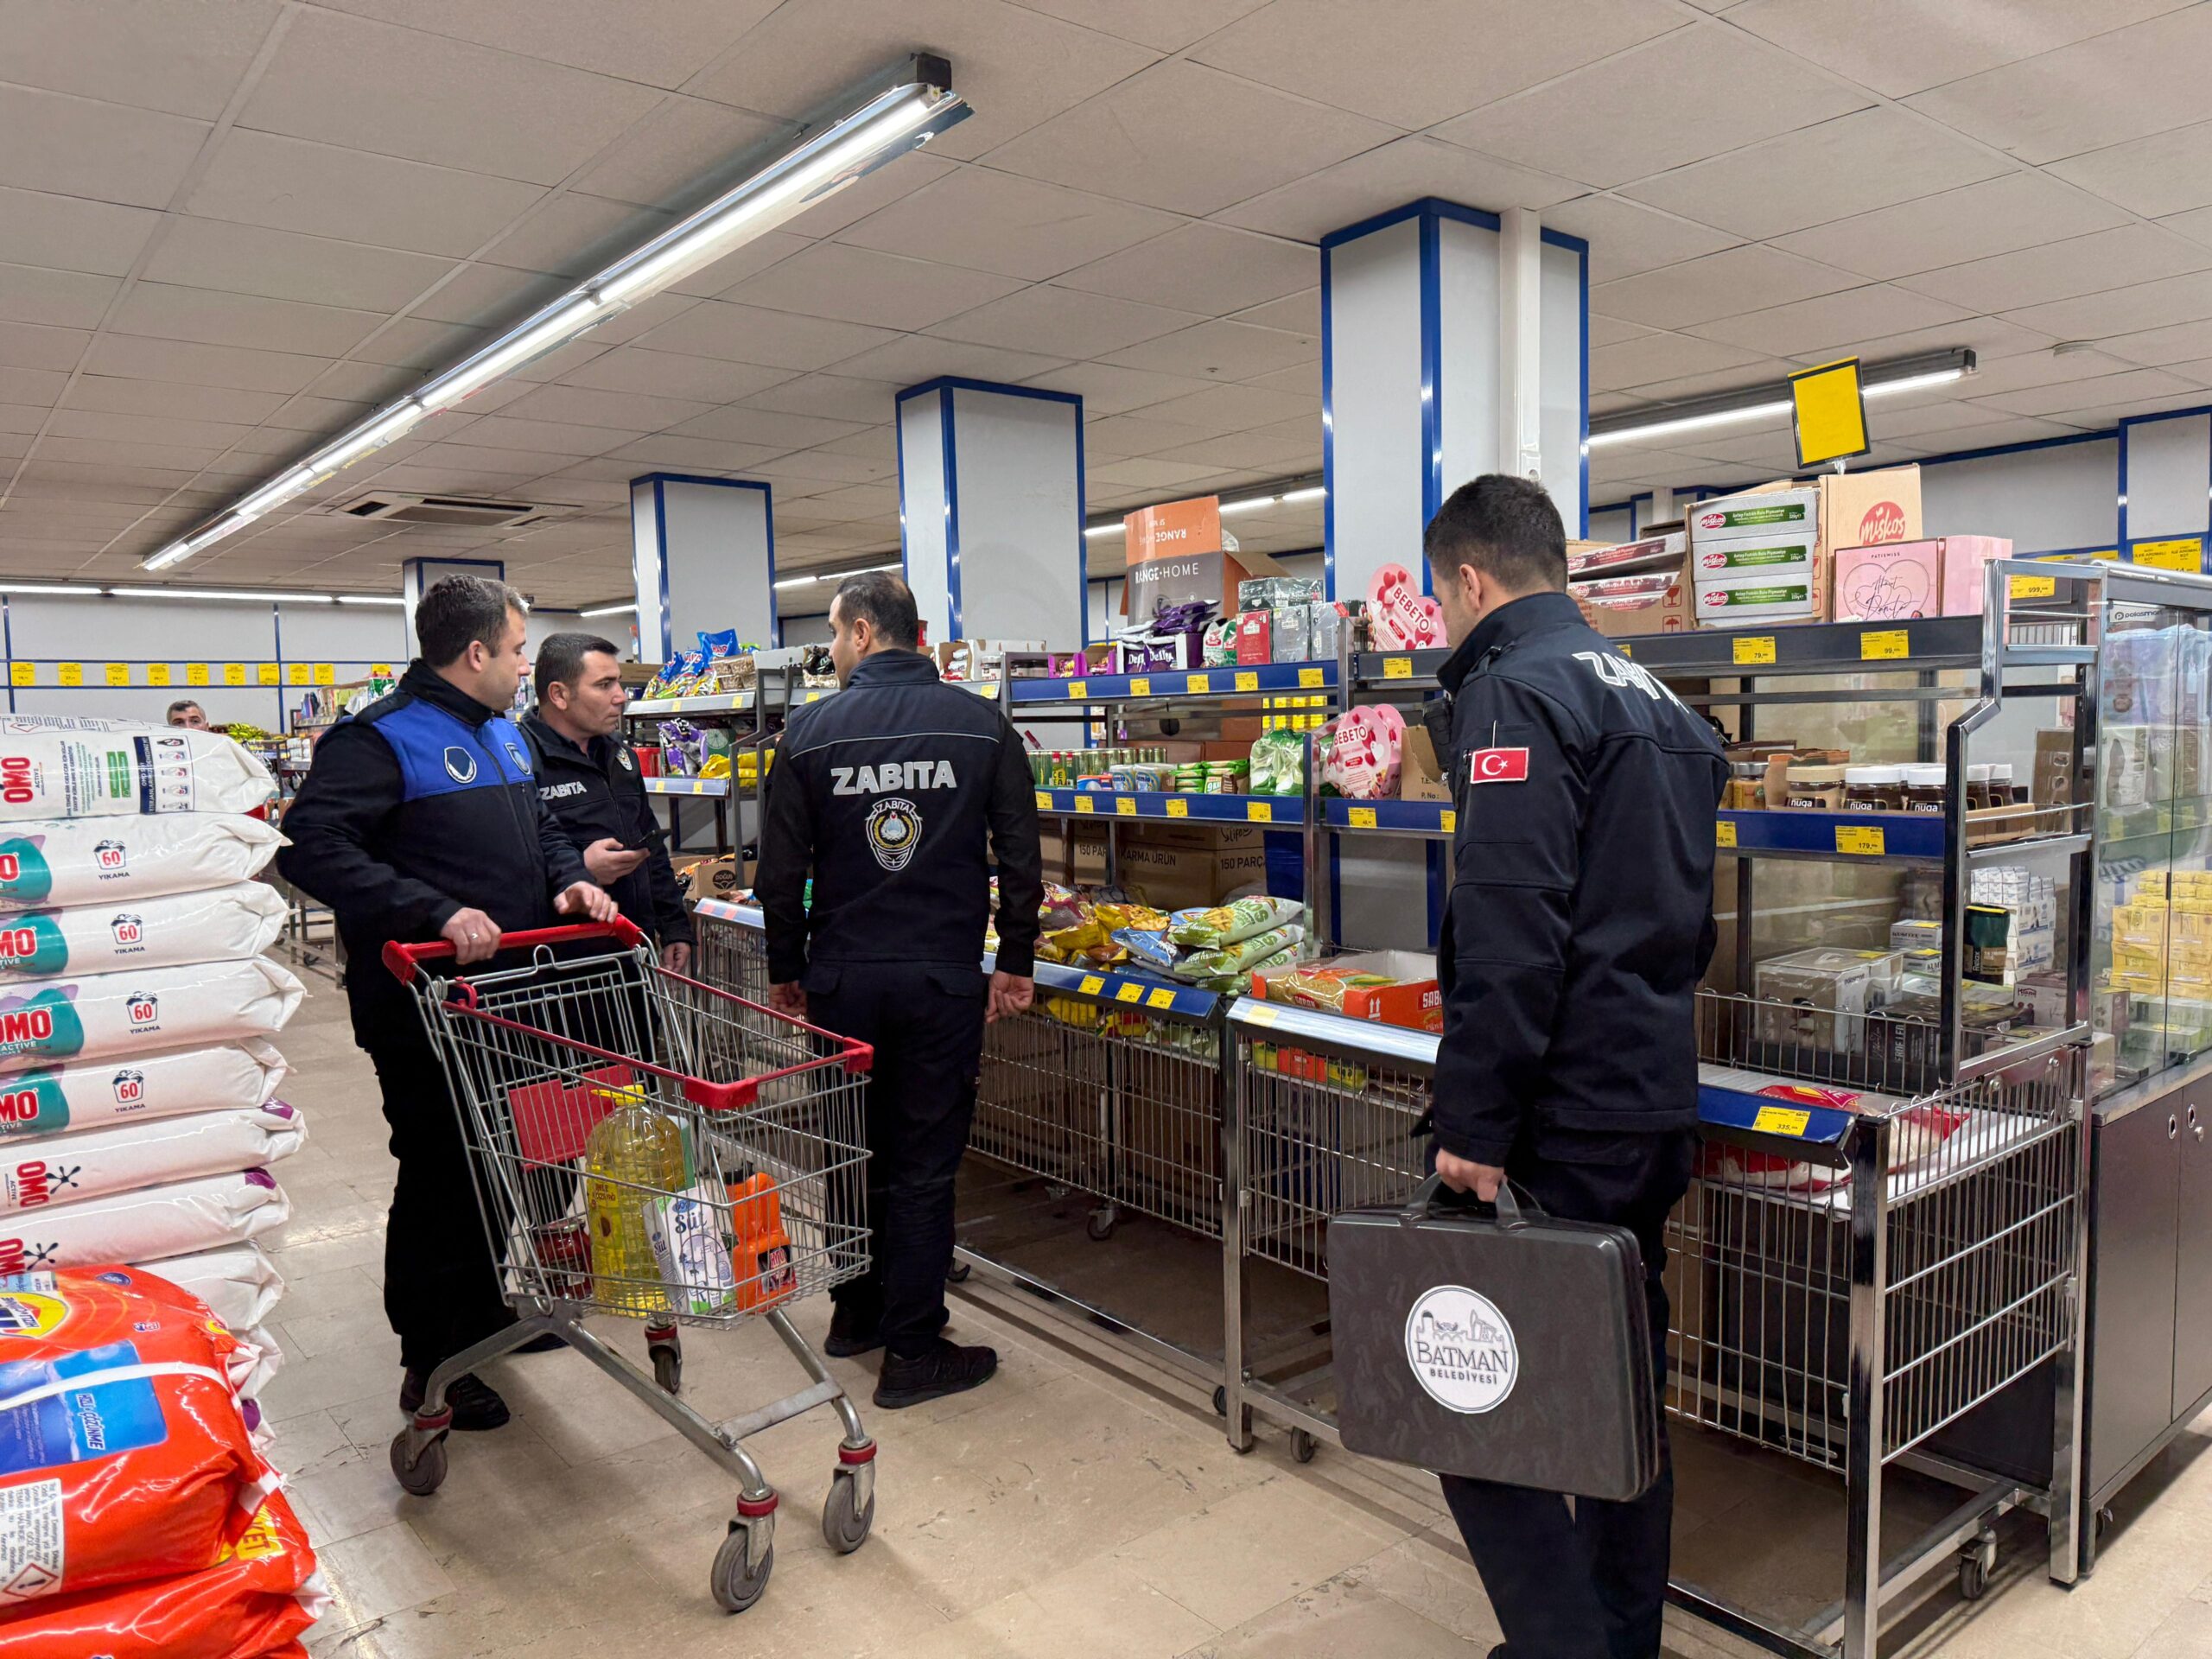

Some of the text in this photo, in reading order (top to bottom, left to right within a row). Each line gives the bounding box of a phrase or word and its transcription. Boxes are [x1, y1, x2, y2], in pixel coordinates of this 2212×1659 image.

[1155, 528, 1186, 542] RANGE
[1860, 512, 1905, 543] miskos
[1163, 563, 1199, 578] HOME
[1393, 587, 1431, 632] BEBETO
[1334, 726, 1366, 745] BEBETO
[1, 756, 34, 804] OMO
[830, 760, 957, 796] ZABITA
[540, 781, 588, 801] ZABITA
[878, 801, 910, 813] ZABITA
[101, 849, 121, 866] 60
[1220, 858, 1235, 870] 150
[99, 870, 130, 880] YIKAMA
[118, 924, 137, 941] 60
[114, 945, 146, 955] YIKAMA
[134, 1002, 153, 1020] 60
[130, 1025, 162, 1034] YIKAMA
[1, 1040, 36, 1052] ACTIVE
[120, 1081, 139, 1099] 60
[114, 1103, 146, 1112] YIKAMA
[16, 1160, 49, 1208] OMO
[675, 1211, 708, 1234] Süt
[0, 1238, 25, 1276] OM
[1414, 1340, 1509, 1373] BATMAN
[1430, 1369, 1497, 1385] BELEDİYESİ
